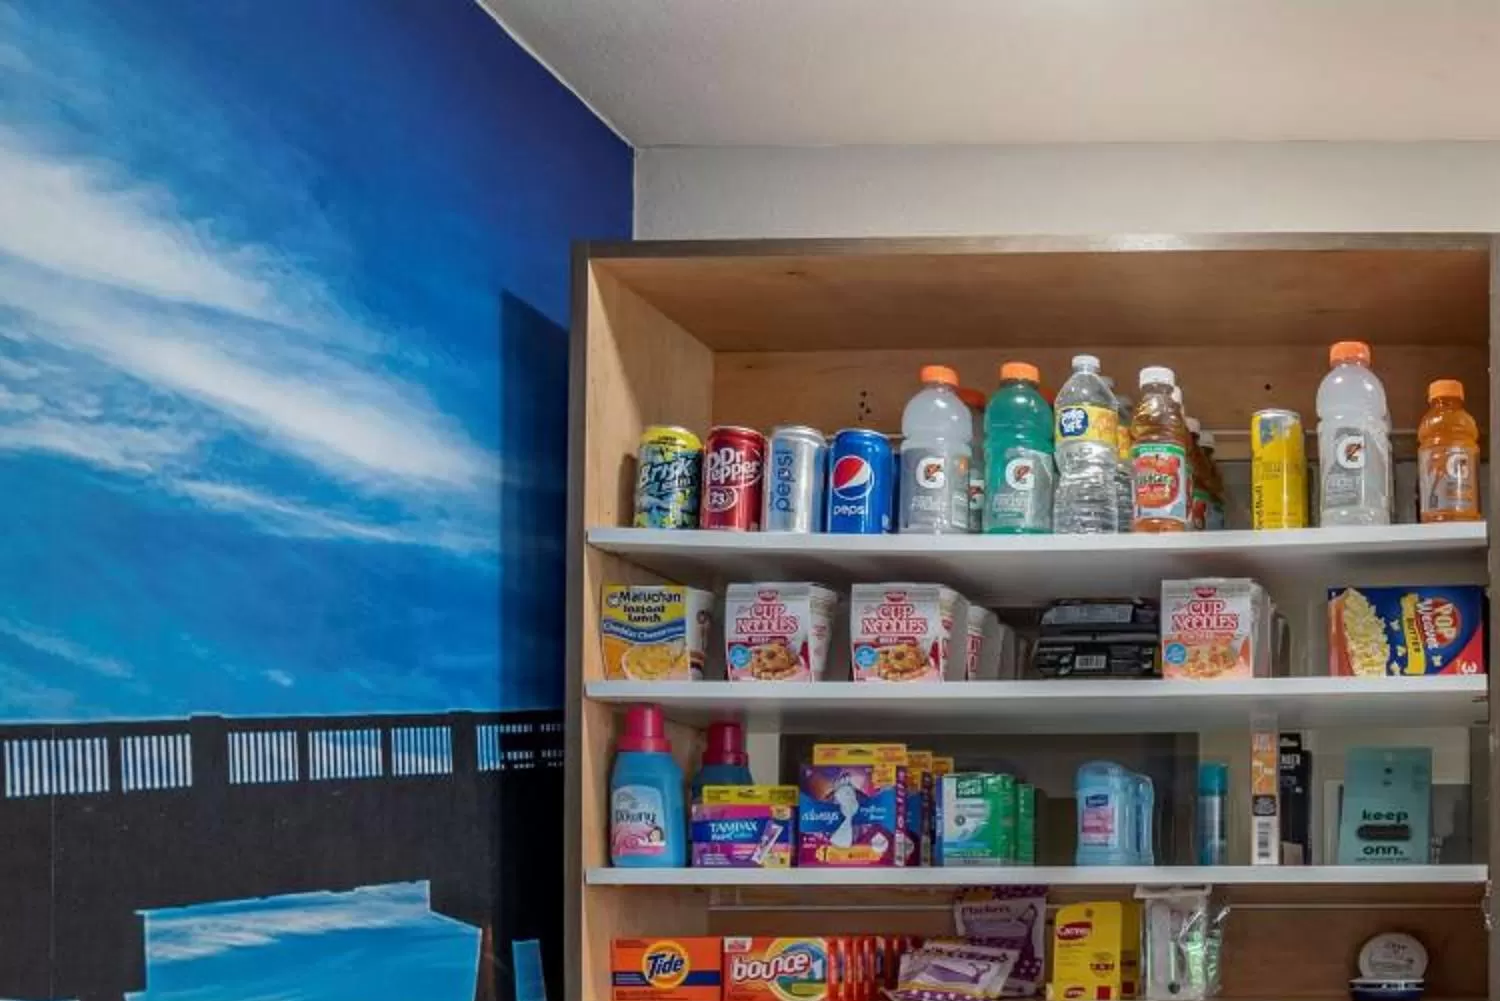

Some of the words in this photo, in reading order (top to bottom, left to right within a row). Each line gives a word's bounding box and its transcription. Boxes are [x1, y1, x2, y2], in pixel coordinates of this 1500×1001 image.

[720, 447, 745, 464] Dr
[707, 452, 760, 485] Pepper
[775, 450, 796, 513] pepsi
[833, 504, 868, 516] peps
[751, 603, 786, 619] CUP
[877, 603, 914, 618] CUP
[1187, 600, 1224, 616] CUP
[735, 616, 799, 634] NOODLES
[862, 617, 928, 634] NOODLES
[1172, 614, 1239, 631] NOODLES
[1362, 809, 1409, 824] keep
[710, 821, 758, 833] TAMPAX
[1363, 845, 1404, 856] onn.
[647, 954, 685, 978] Tide
[733, 951, 811, 983] bounce
